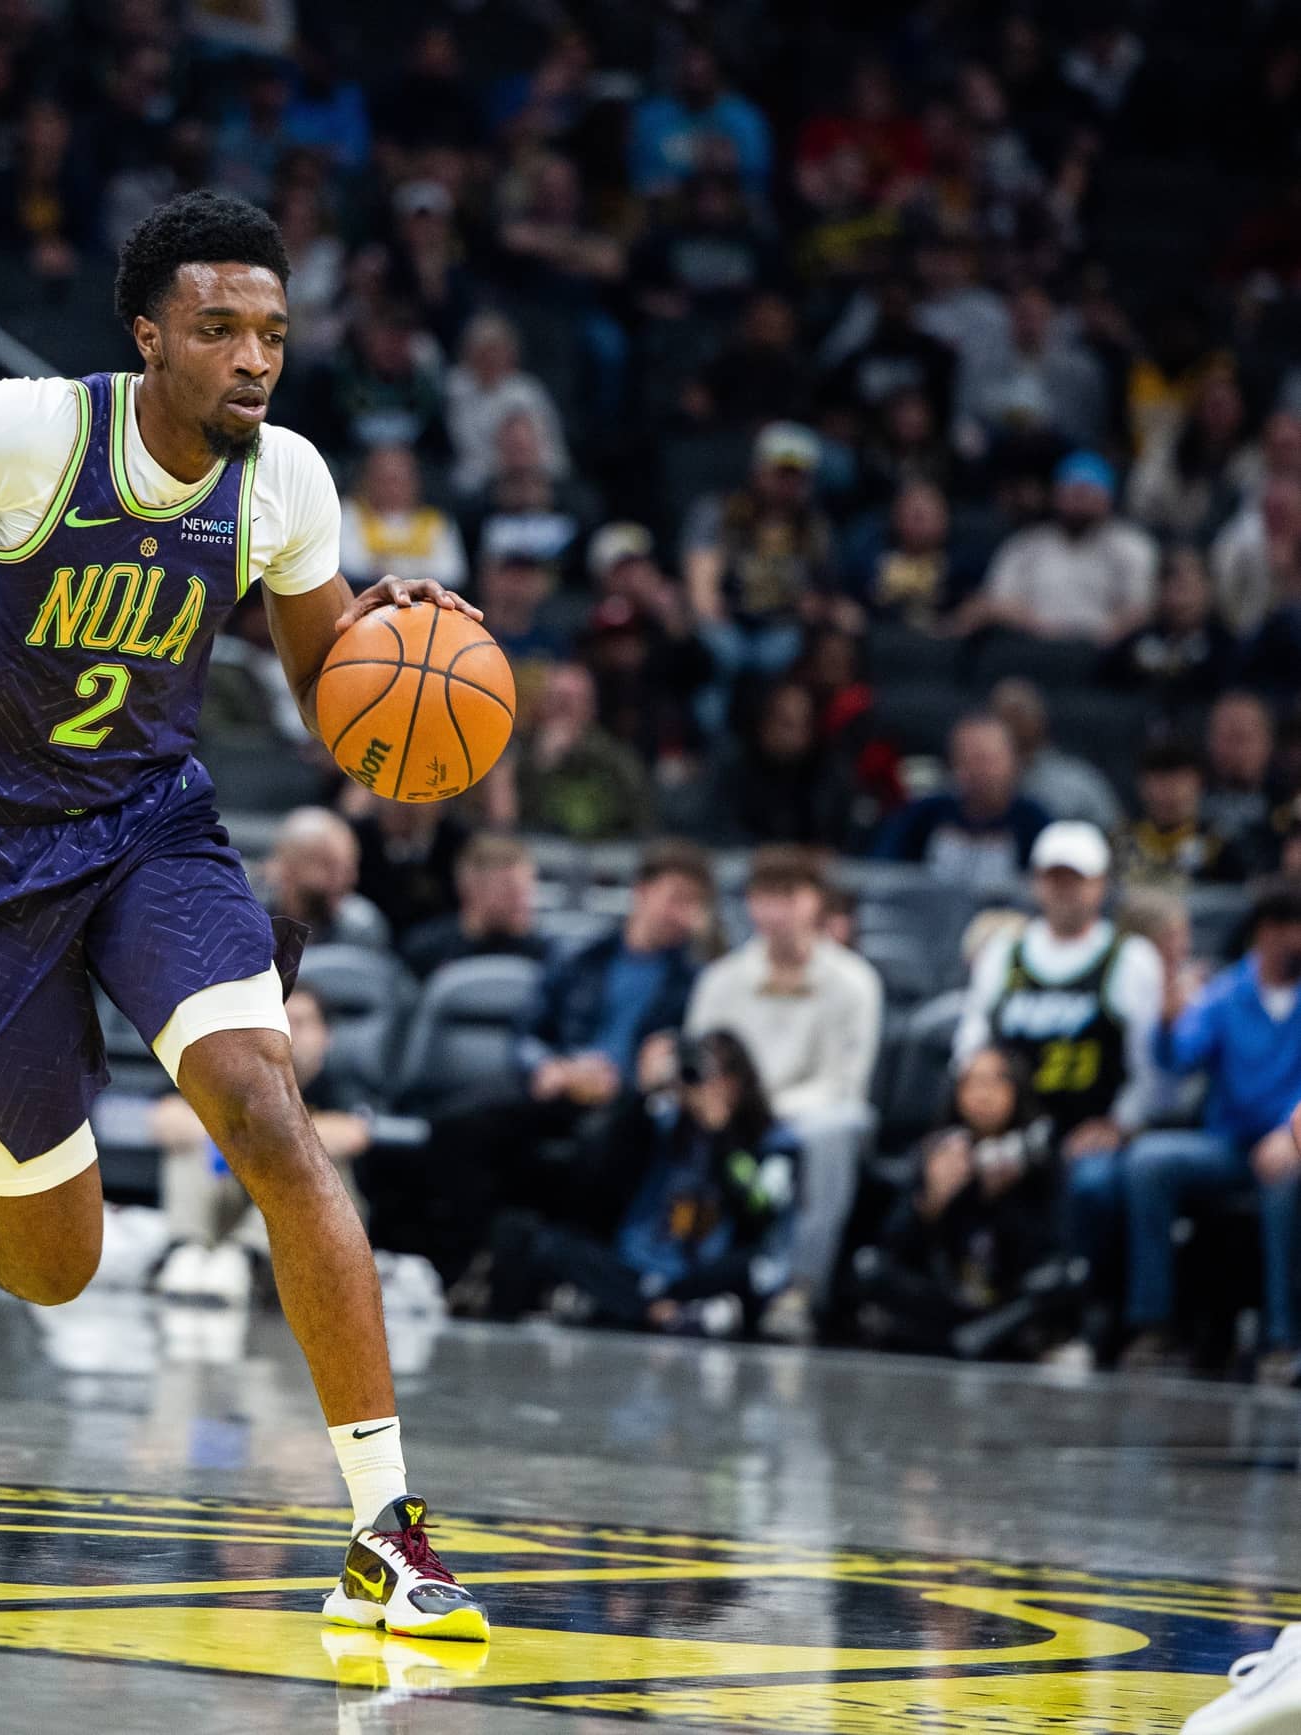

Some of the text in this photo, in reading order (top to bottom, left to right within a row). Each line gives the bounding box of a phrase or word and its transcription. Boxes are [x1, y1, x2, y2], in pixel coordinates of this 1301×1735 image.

[180, 532, 234, 545] PRODUCTS
[182, 517, 235, 534] NEWAGE
[26, 562, 207, 665] NOLA
[48, 663, 131, 749] 2
